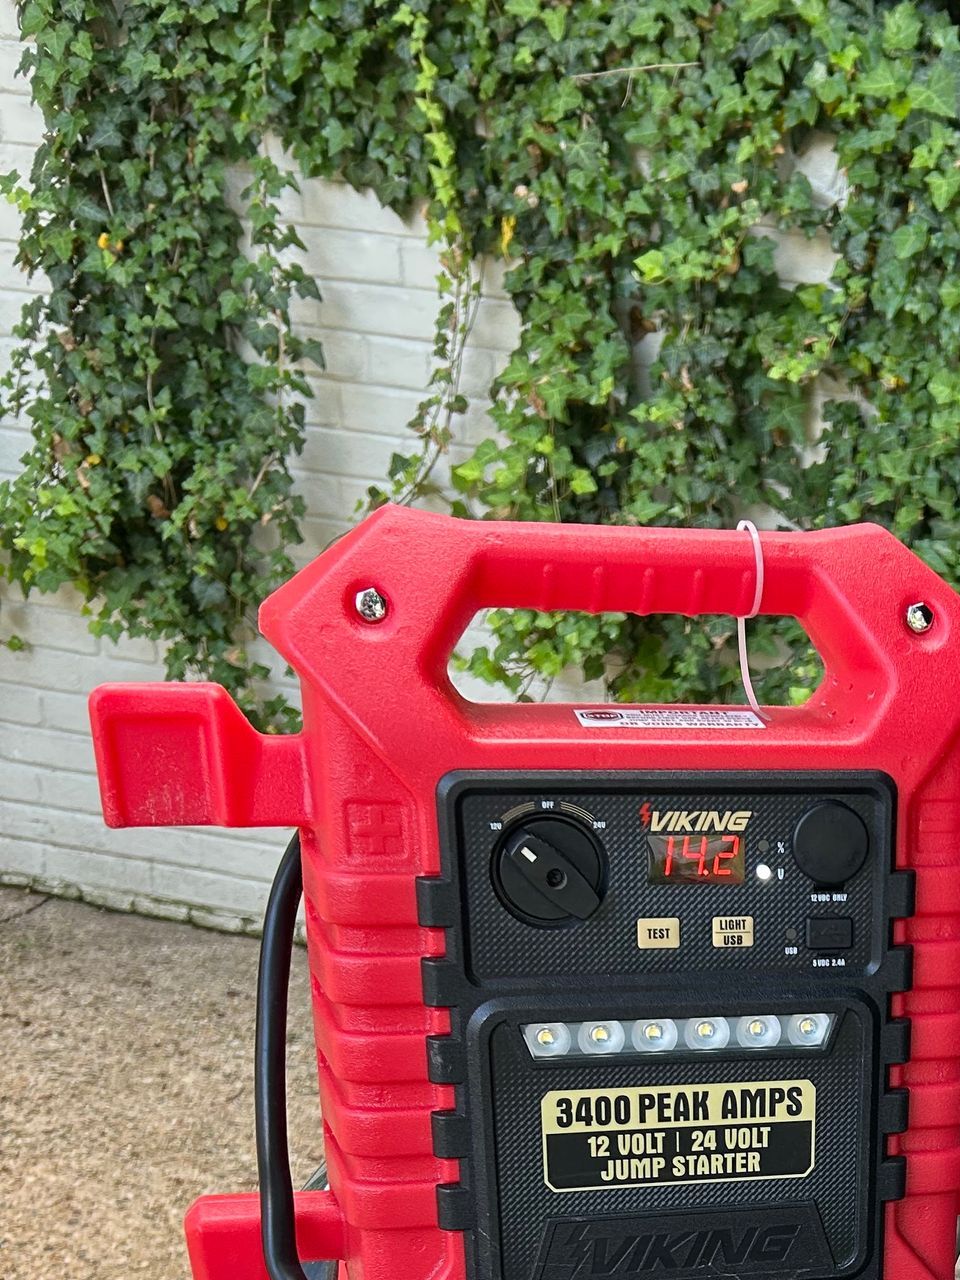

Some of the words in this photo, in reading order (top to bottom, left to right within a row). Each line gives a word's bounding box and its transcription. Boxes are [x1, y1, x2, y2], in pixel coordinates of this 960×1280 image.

[541, 801, 555, 809] OFF
[650, 811, 752, 832] VIKING
[664, 835, 740, 876] 14.2
[832, 893, 848, 902] ONLY
[719, 919, 747, 930] LIGHT
[647, 928, 671, 939] TEST
[723, 935, 743, 946] USB
[785, 946, 798, 955] USB
[556, 1094, 632, 1128] 3400
[638, 1090, 710, 1124] PEAK
[721, 1086, 804, 1119] AMPS
[587, 1135, 610, 1157] 12
[617, 1131, 666, 1156] VOLT
[691, 1129, 717, 1152] 24
[724, 1126, 771, 1150] VOLT
[601, 1155, 666, 1181] JUMP
[672, 1151, 761, 1177] STARTER
[587, 1224, 801, 1275] VIKING
